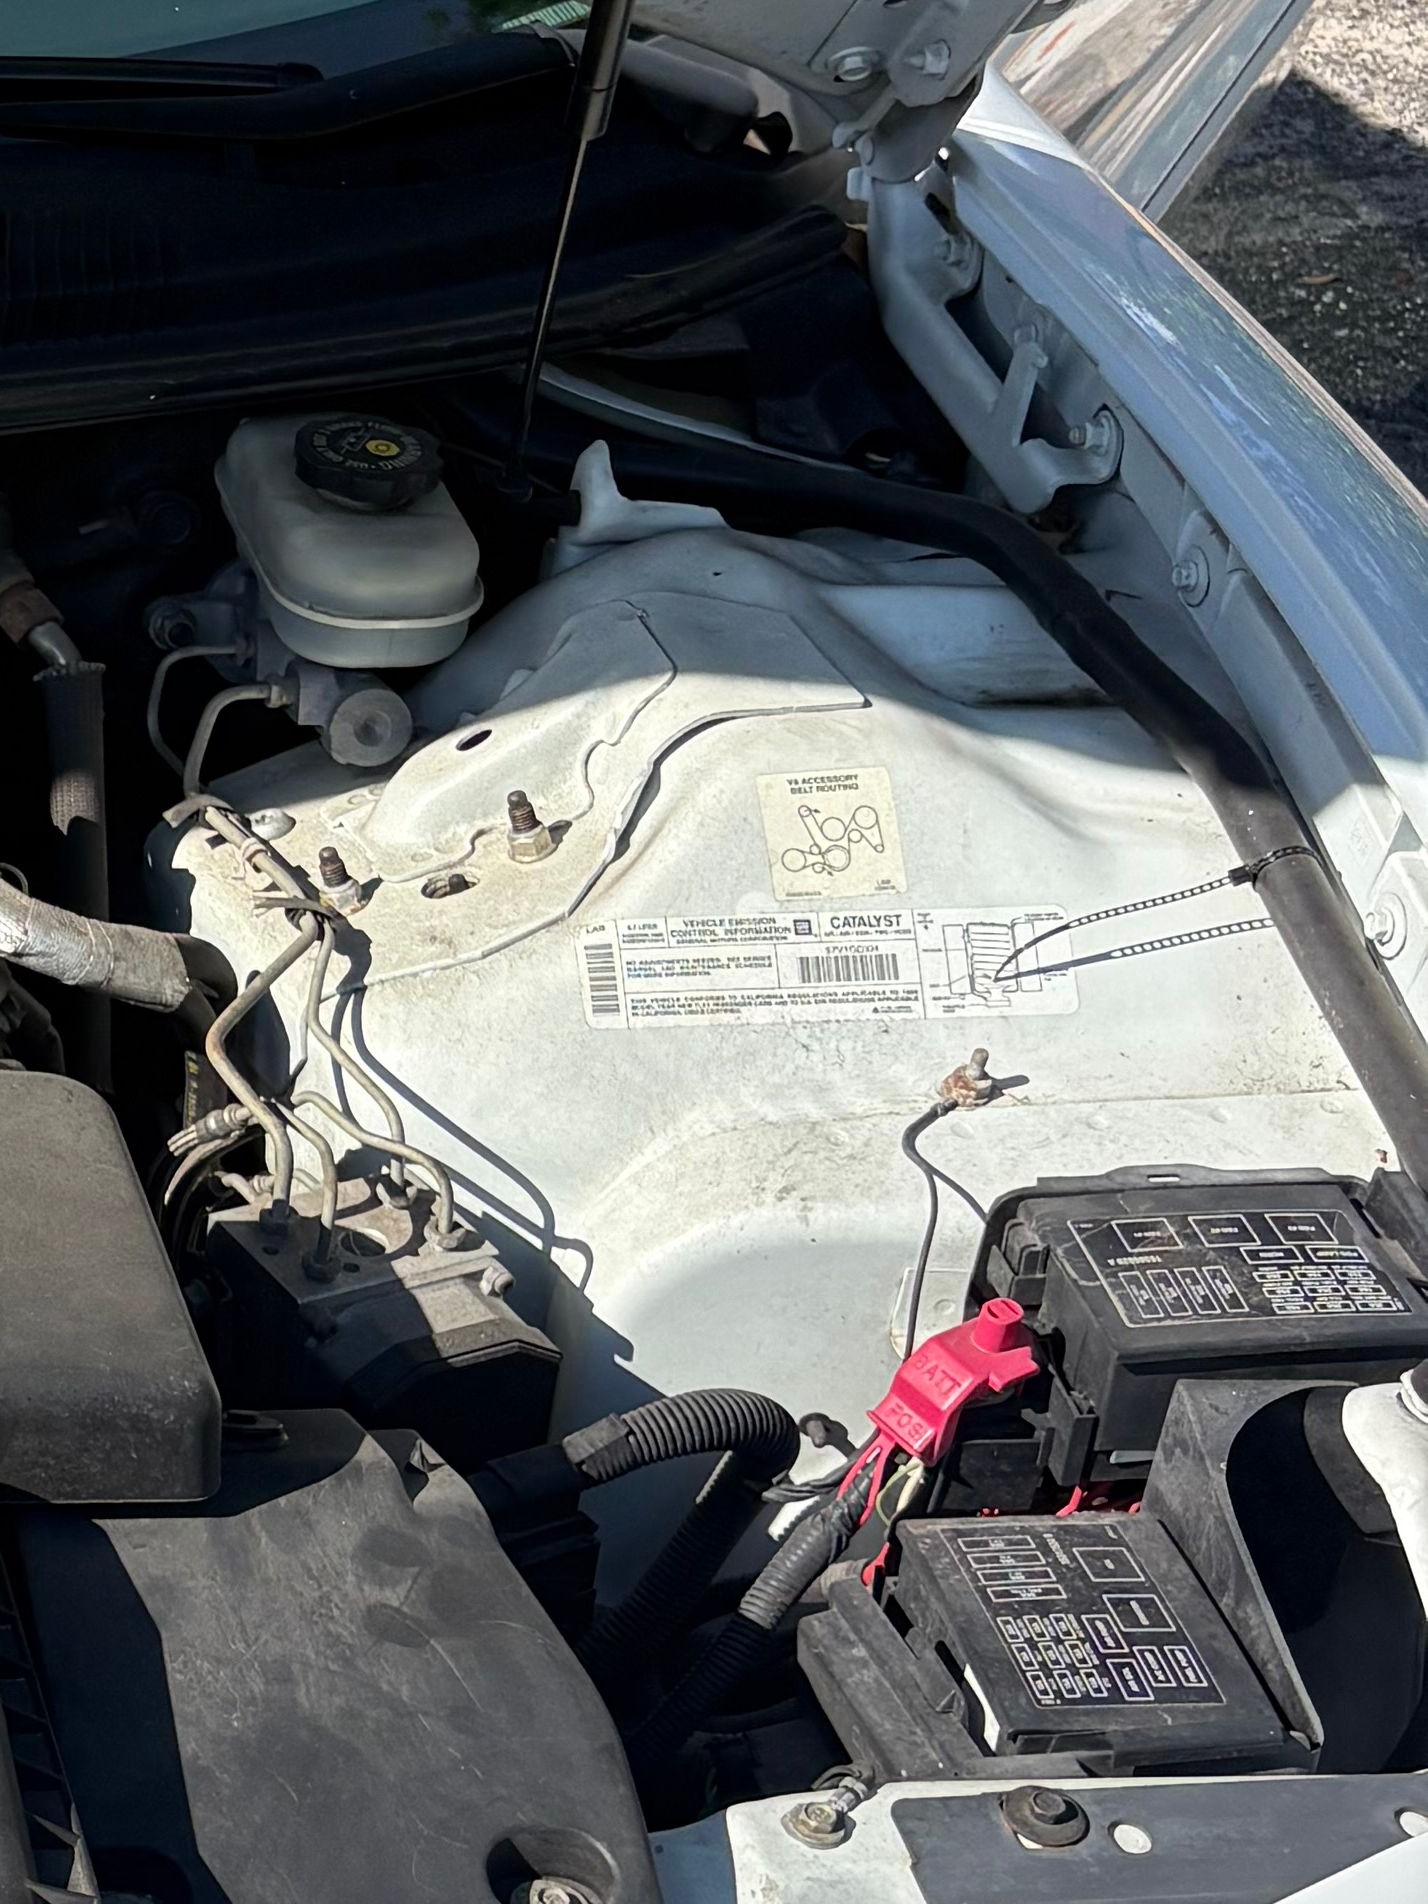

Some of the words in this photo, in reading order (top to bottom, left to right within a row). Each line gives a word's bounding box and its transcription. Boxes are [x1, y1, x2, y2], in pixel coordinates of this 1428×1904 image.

[801, 774, 859, 785] ACCESSORY
[790, 786, 814, 795] BELT
[815, 783, 859, 794] ROUTING
[682, 918, 727, 928] VEHICLE
[728, 916, 777, 927] EMISSION
[830, 914, 903, 930] CATALYST
[670, 927, 719, 938] CONTROL
[723, 925, 792, 937] INFORMATION
[913, 1353, 963, 1397] BATT
